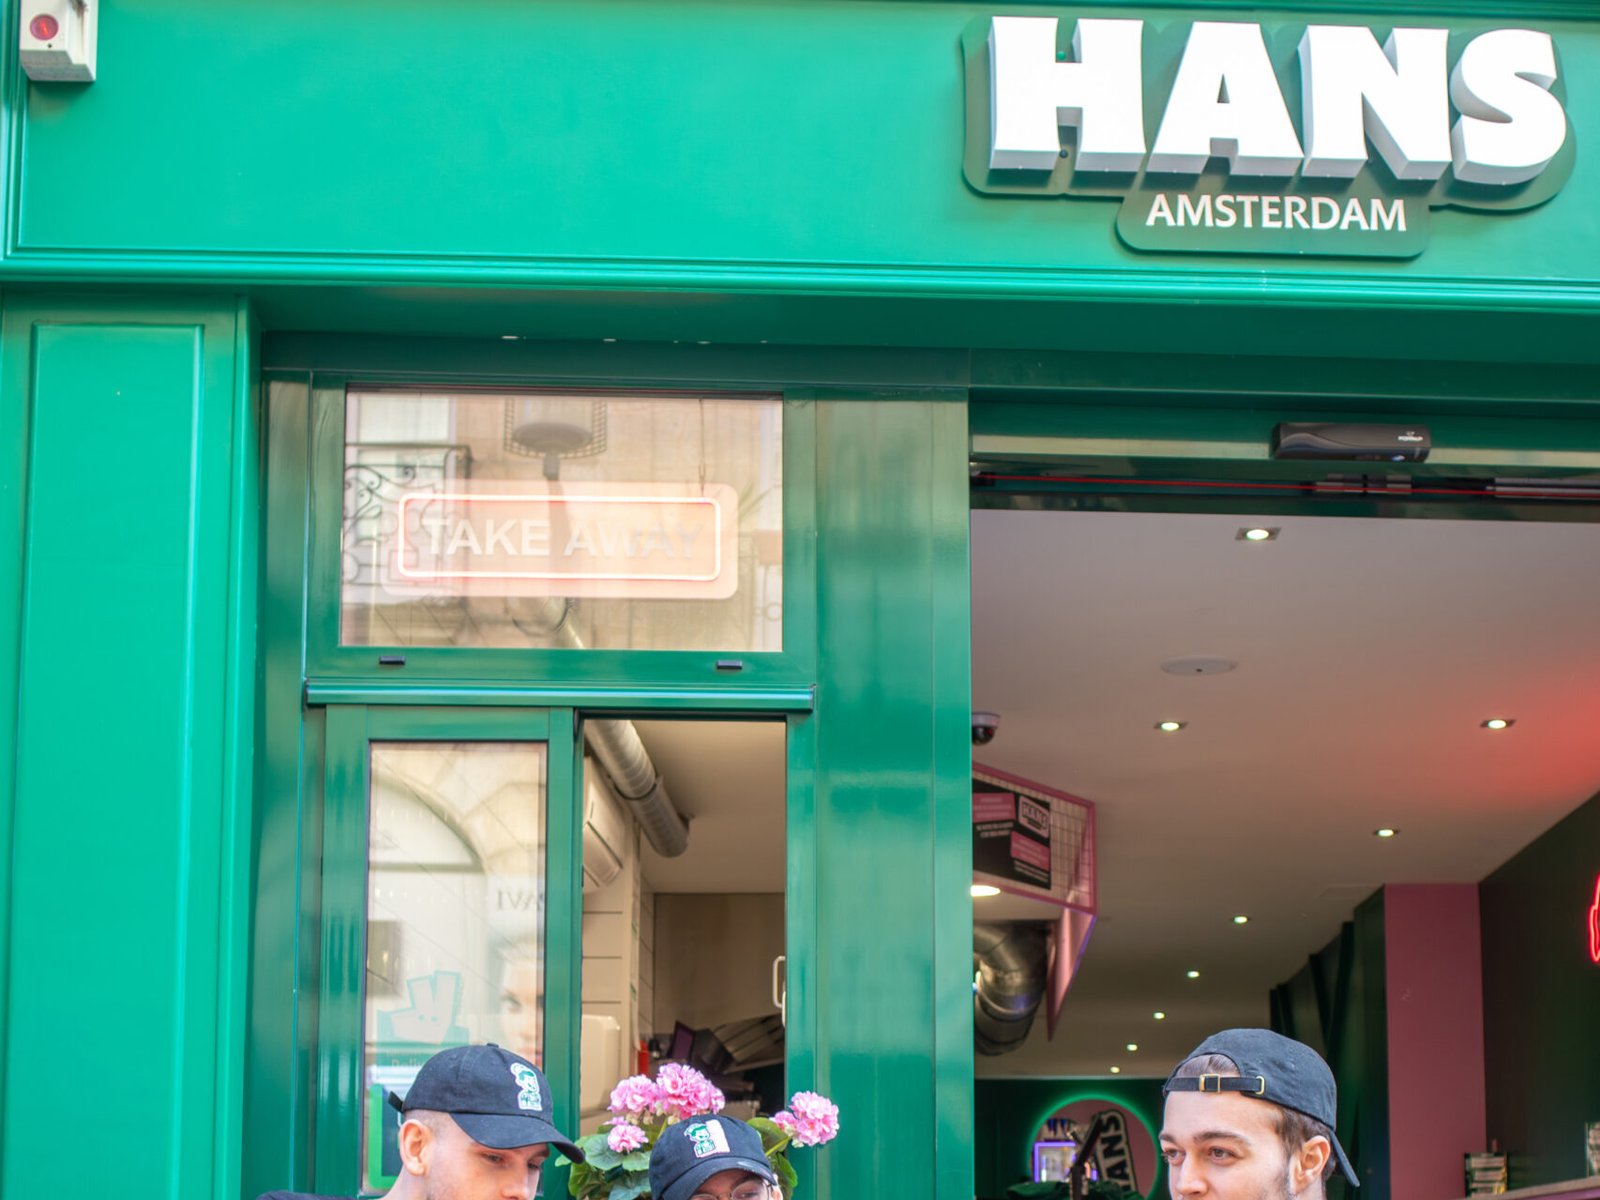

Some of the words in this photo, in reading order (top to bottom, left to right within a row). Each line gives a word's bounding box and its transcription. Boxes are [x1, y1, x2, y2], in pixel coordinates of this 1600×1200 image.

[988, 15, 1568, 185] HANS
[1145, 193, 1407, 232] AMSTERDAM
[421, 517, 550, 556] TAKE
[563, 522, 703, 560] AWAY
